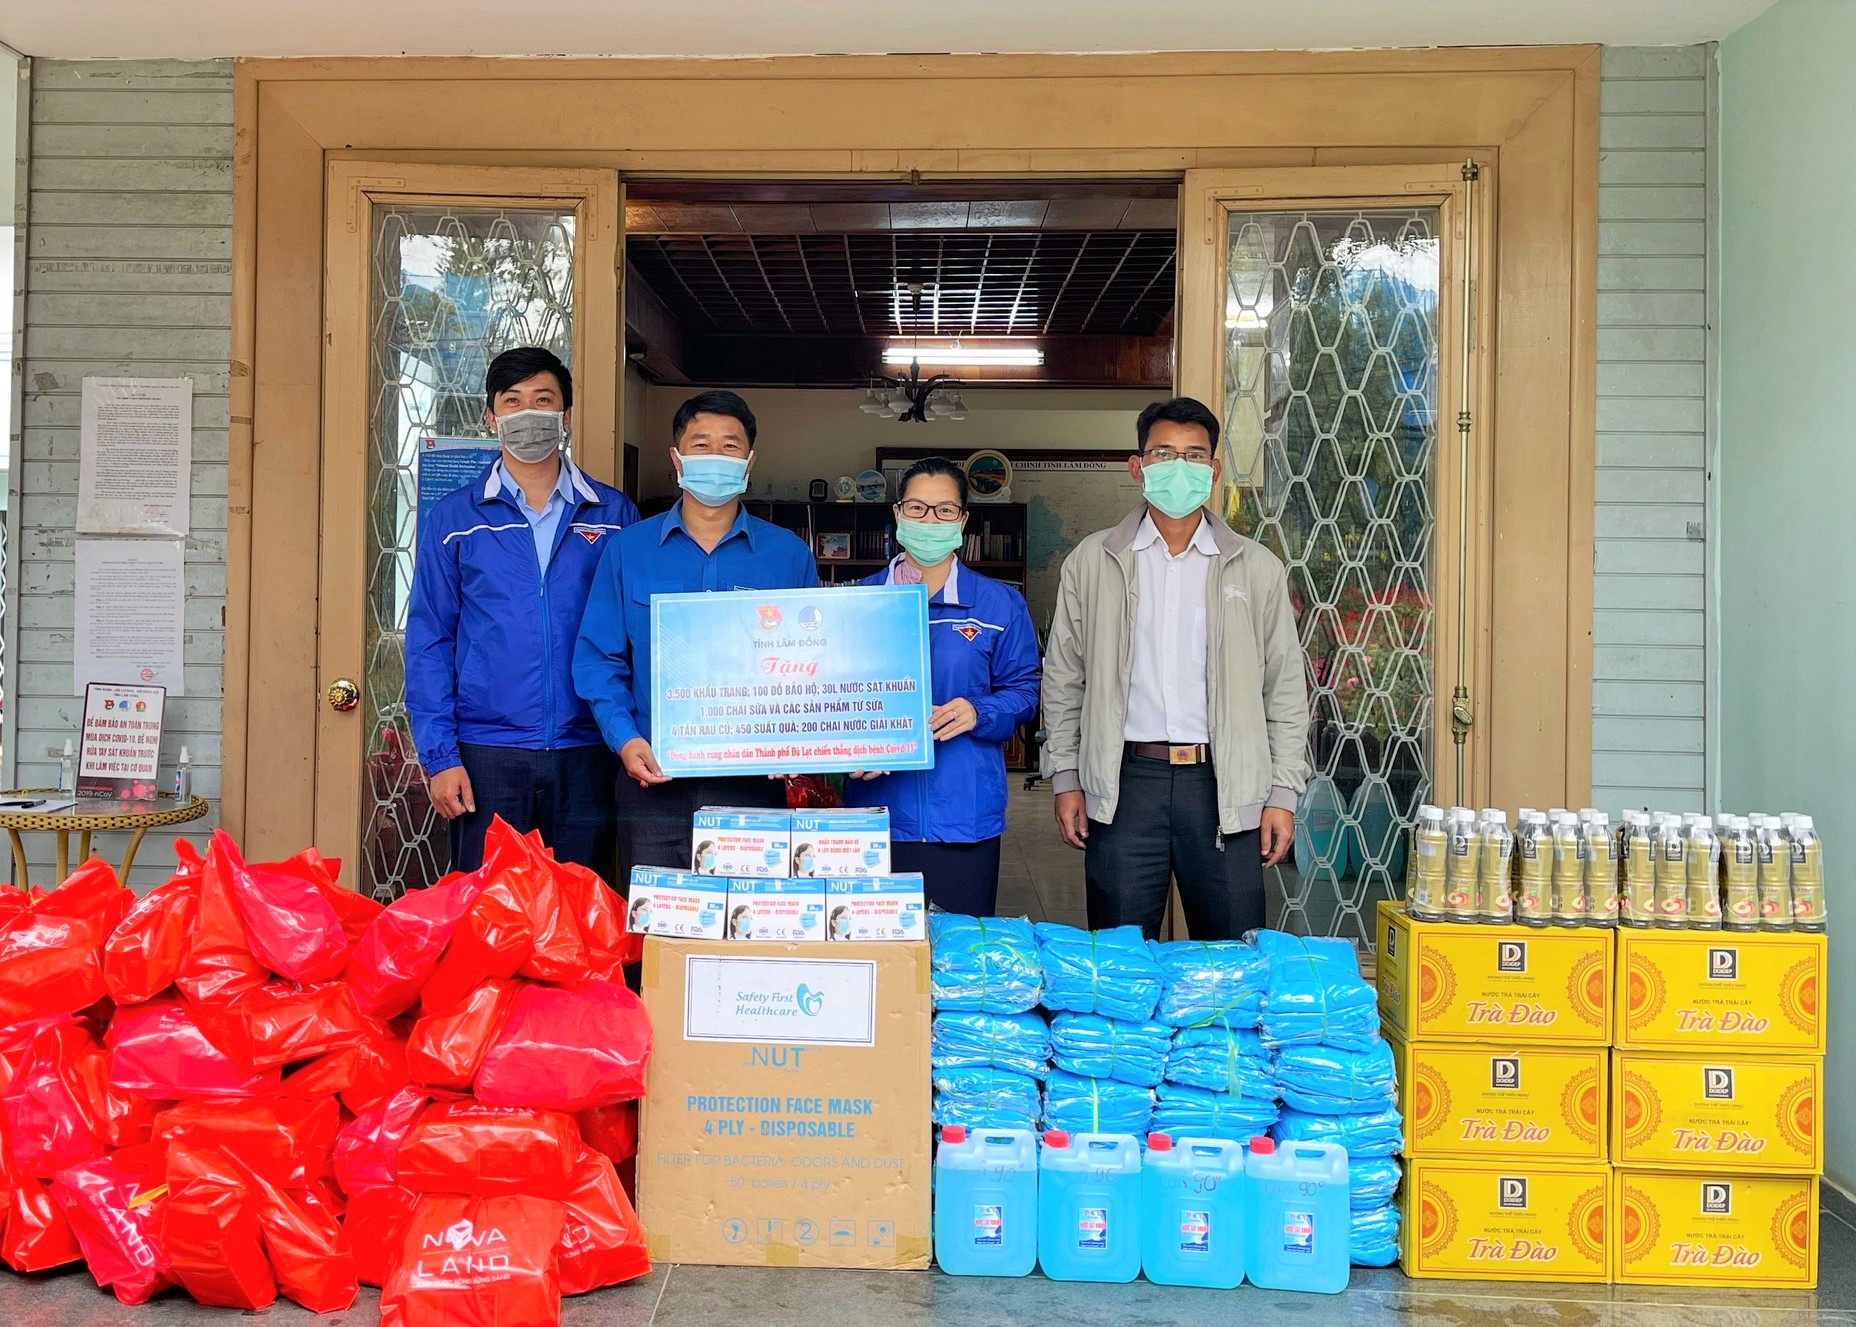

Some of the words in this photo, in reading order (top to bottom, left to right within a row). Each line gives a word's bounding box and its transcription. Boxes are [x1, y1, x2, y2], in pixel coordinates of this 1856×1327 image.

[753, 638, 774, 648] TỈNH
[777, 638, 796, 648] LÂM
[798, 636, 828, 647] ĐỒNG
[761, 657, 818, 676] Tặng
[667, 688, 690, 700] 3.500
[720, 687, 750, 698] TRANG;
[754, 686, 768, 696] 100
[822, 684, 838, 694] 30L
[700, 706, 724, 717] 1.000
[726, 705, 746, 716] CHAI
[672, 726, 677, 736] 4
[700, 725, 716, 736] RAU
[736, 724, 751, 734] 450
[802, 722, 818, 732] 200
[820, 721, 840, 732] CHAI
[86, 762, 94, 770] KHI
[698, 816, 722, 826] NUT
[796, 820, 820, 829] NUT
[636, 873, 660, 884] NUT
[733, 881, 756, 891] NUT
[831, 881, 855, 891] NUT
[736, 991, 769, 1004] Safety
[772, 992, 793, 1002] First
[736, 1004, 798, 1016] Healthcare
[1467, 1002, 1502, 1022] Trà
[1508, 1004, 1556, 1024] Đào
[1677, 1010, 1713, 1030] Trà
[1720, 1012, 1768, 1031] Đào
[752, 1046, 804, 1067] NUT
[687, 1095, 781, 1114] PROTECTION
[786, 1097, 822, 1114] FACE
[828, 1098, 873, 1116] MASK
[704, 1120, 713, 1135] 4
[718, 1120, 744, 1136] PLY
[761, 1120, 856, 1138] DISPOSABLE
[1462, 1120, 1497, 1139] Trà
[1502, 1121, 1550, 1140] Đào
[1673, 1130, 1710, 1149] Trà
[1716, 1132, 1765, 1151] Đào
[657, 1153, 690, 1165] FILTER
[695, 1154, 720, 1165] FOR
[791, 1156, 837, 1168] ODORS
[841, 1157, 870, 1169] AND
[874, 1158, 904, 1169] DUST
[730, 1177, 744, 1187] 50
[752, 1177, 788, 1188] boxes
[801, 1178, 809, 1189] 4
[812, 1178, 829, 1192] ply
[1469, 1239, 1504, 1258] Trà
[1509, 1240, 1556, 1260] Đào
[1671, 1244, 1707, 1263] Trà
[1712, 1245, 1760, 1264] Đào
[418, 1255, 508, 1278] LAND
